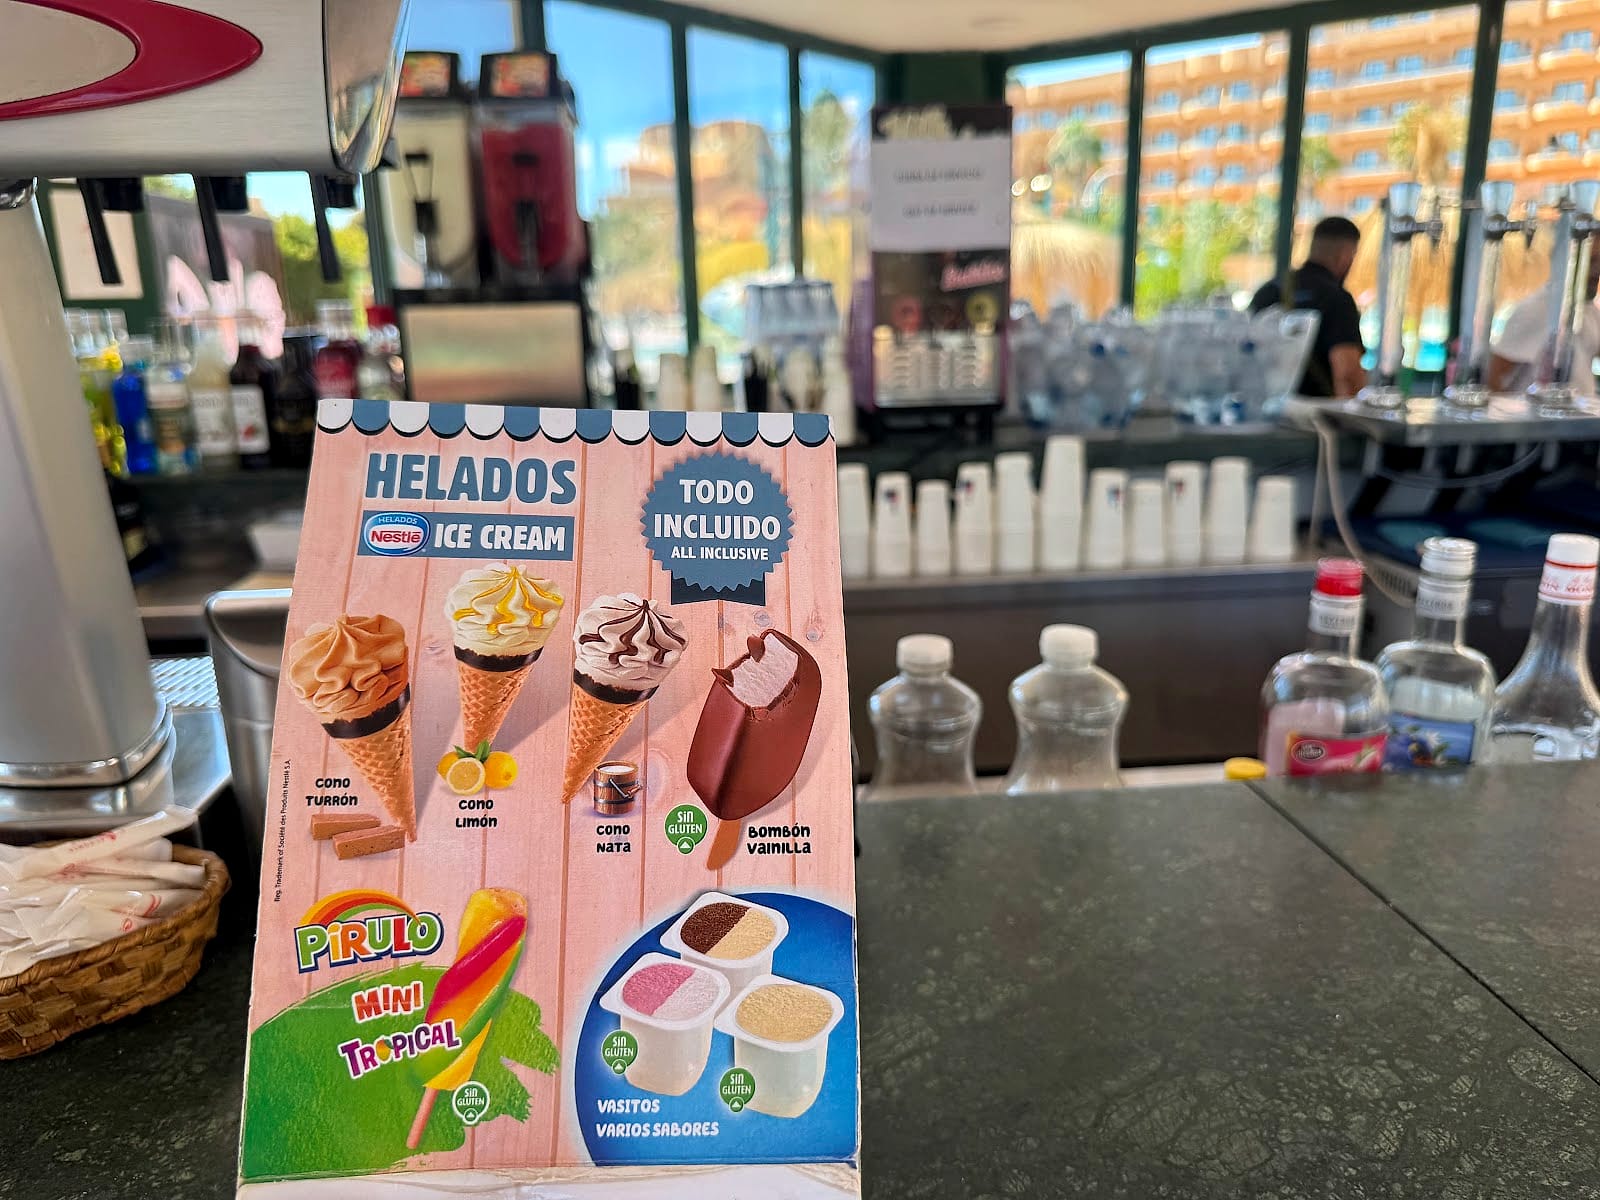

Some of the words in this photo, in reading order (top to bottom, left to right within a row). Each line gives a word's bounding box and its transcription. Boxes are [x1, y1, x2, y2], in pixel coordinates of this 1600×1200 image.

[365, 453, 577, 505] HELADOS
[679, 479, 754, 505] TODO
[378, 515, 418, 525] HELADOS
[654, 513, 781, 541] INCLUIDO
[370, 529, 422, 544] Nestlé
[434, 523, 473, 549] ICE
[480, 524, 566, 551] CREAM
[670, 546, 697, 559] ALL
[700, 546, 769, 561] INCLUSIVE
[315, 777, 351, 789] CONO
[281, 789, 289, 814] Produits
[305, 792, 358, 807] TURRÓN
[458, 799, 494, 811] CONO
[455, 814, 498, 829] LIMÓN
[677, 810, 694, 823] SIN
[596, 824, 631, 836] CONO
[667, 823, 703, 835] GLUTEN
[748, 822, 811, 838] BOMBÓN
[278, 826, 286, 848] Société
[278, 848, 284, 856] of
[596, 841, 631, 853] NATA
[746, 841, 812, 855] VAINILLA
[275, 856, 284, 889] Trademark
[295, 912, 444, 973] PIRULO
[353, 982, 423, 1022] MINI
[340, 1020, 461, 1078] TROPICAL
[612, 1036, 627, 1047] SIN
[604, 1047, 634, 1057] GLUTEN
[729, 1073, 745, 1085] SIN
[464, 1088, 478, 1097] SIN
[721, 1085, 752, 1095] GLUTEN
[456, 1097, 485, 1107] GLUTEN
[597, 1099, 661, 1114] VASITOS
[595, 1123, 650, 1137] VARIOS
[652, 1121, 720, 1137] SABORES
